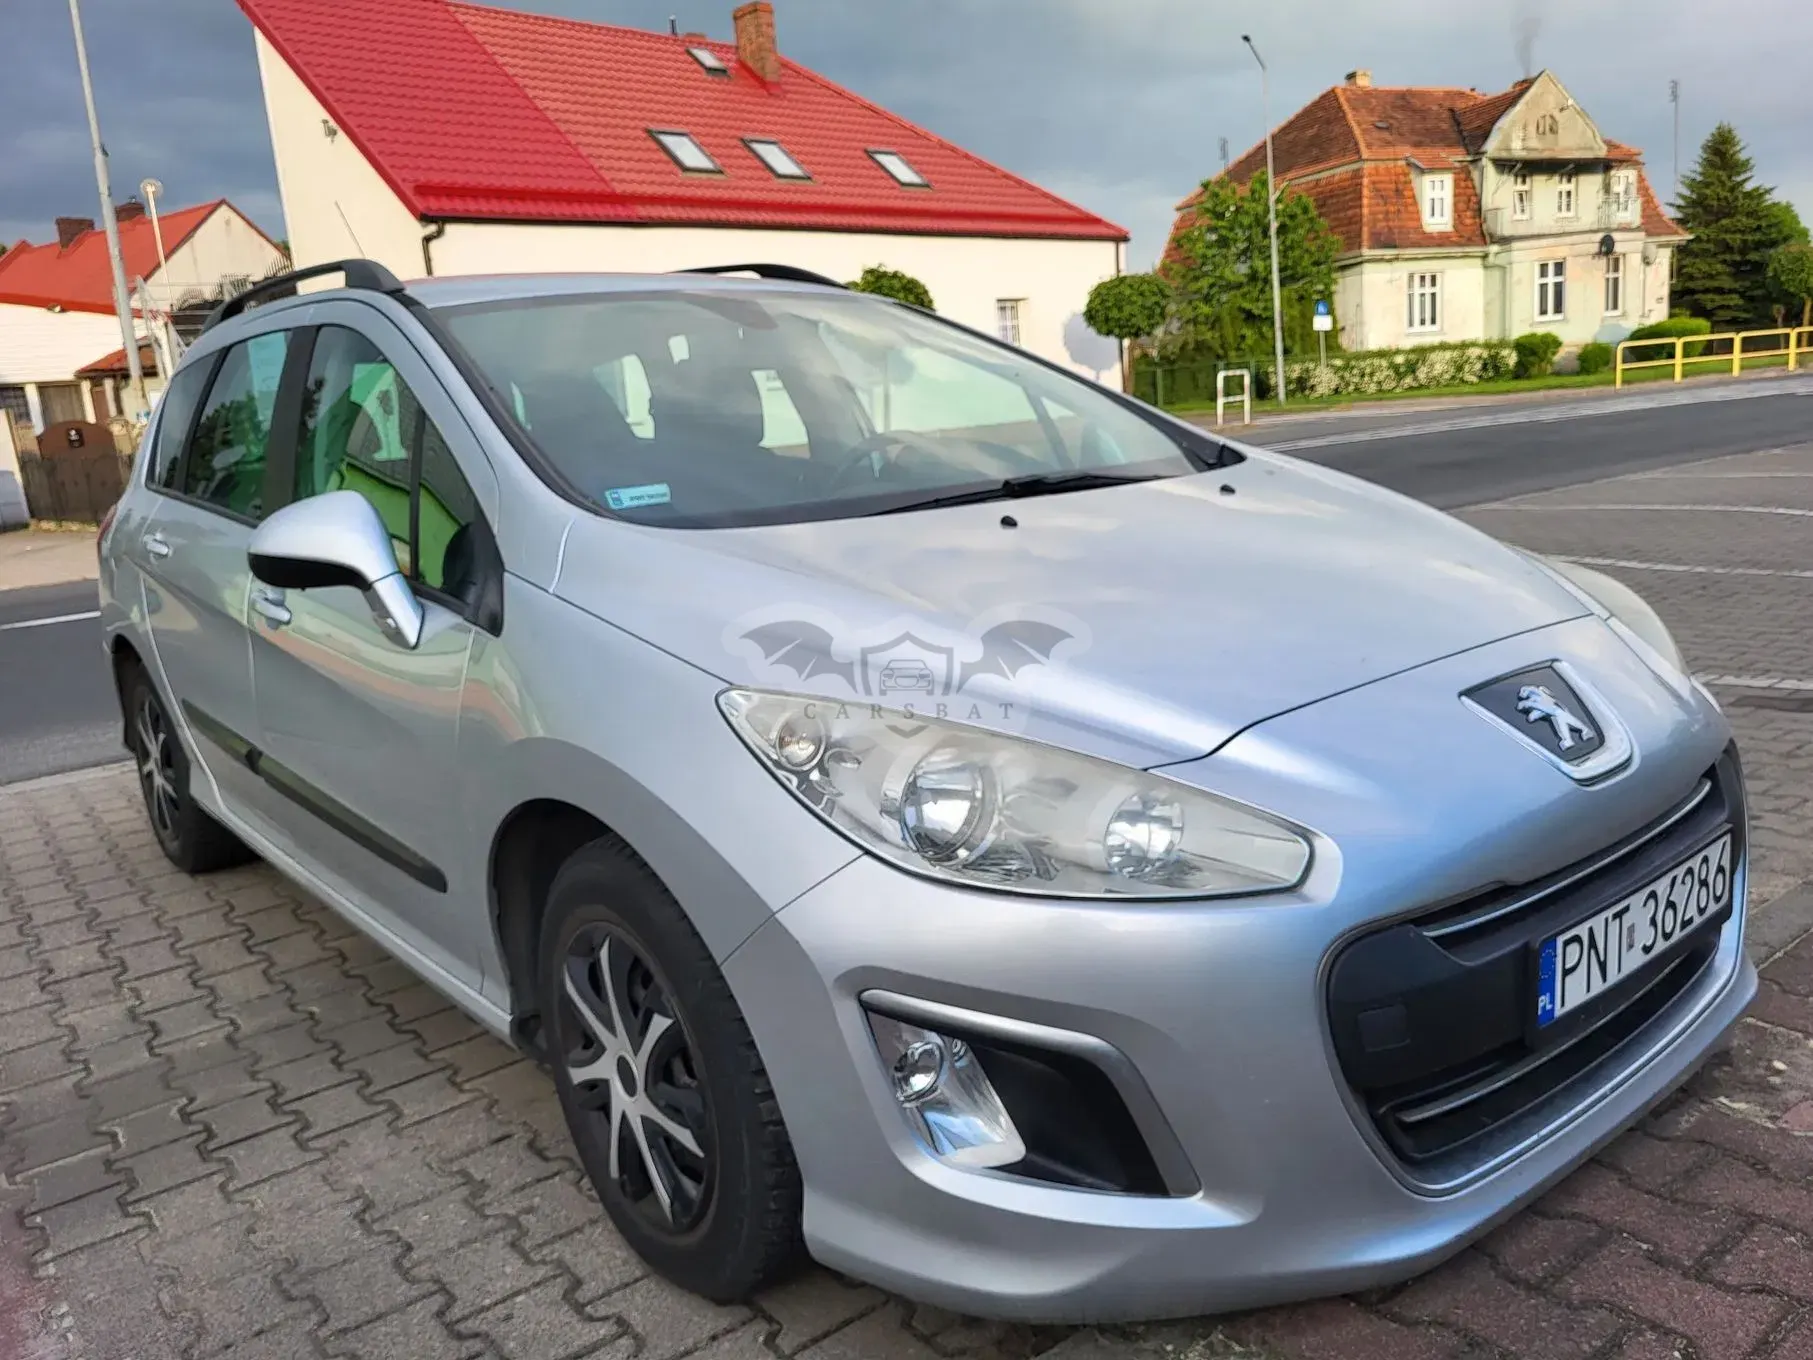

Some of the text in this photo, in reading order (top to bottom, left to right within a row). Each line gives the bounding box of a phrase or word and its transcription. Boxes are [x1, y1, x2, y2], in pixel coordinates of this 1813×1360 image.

[1560, 839, 1727, 1008] PNT 36286
[1537, 992, 1553, 1015] PL
